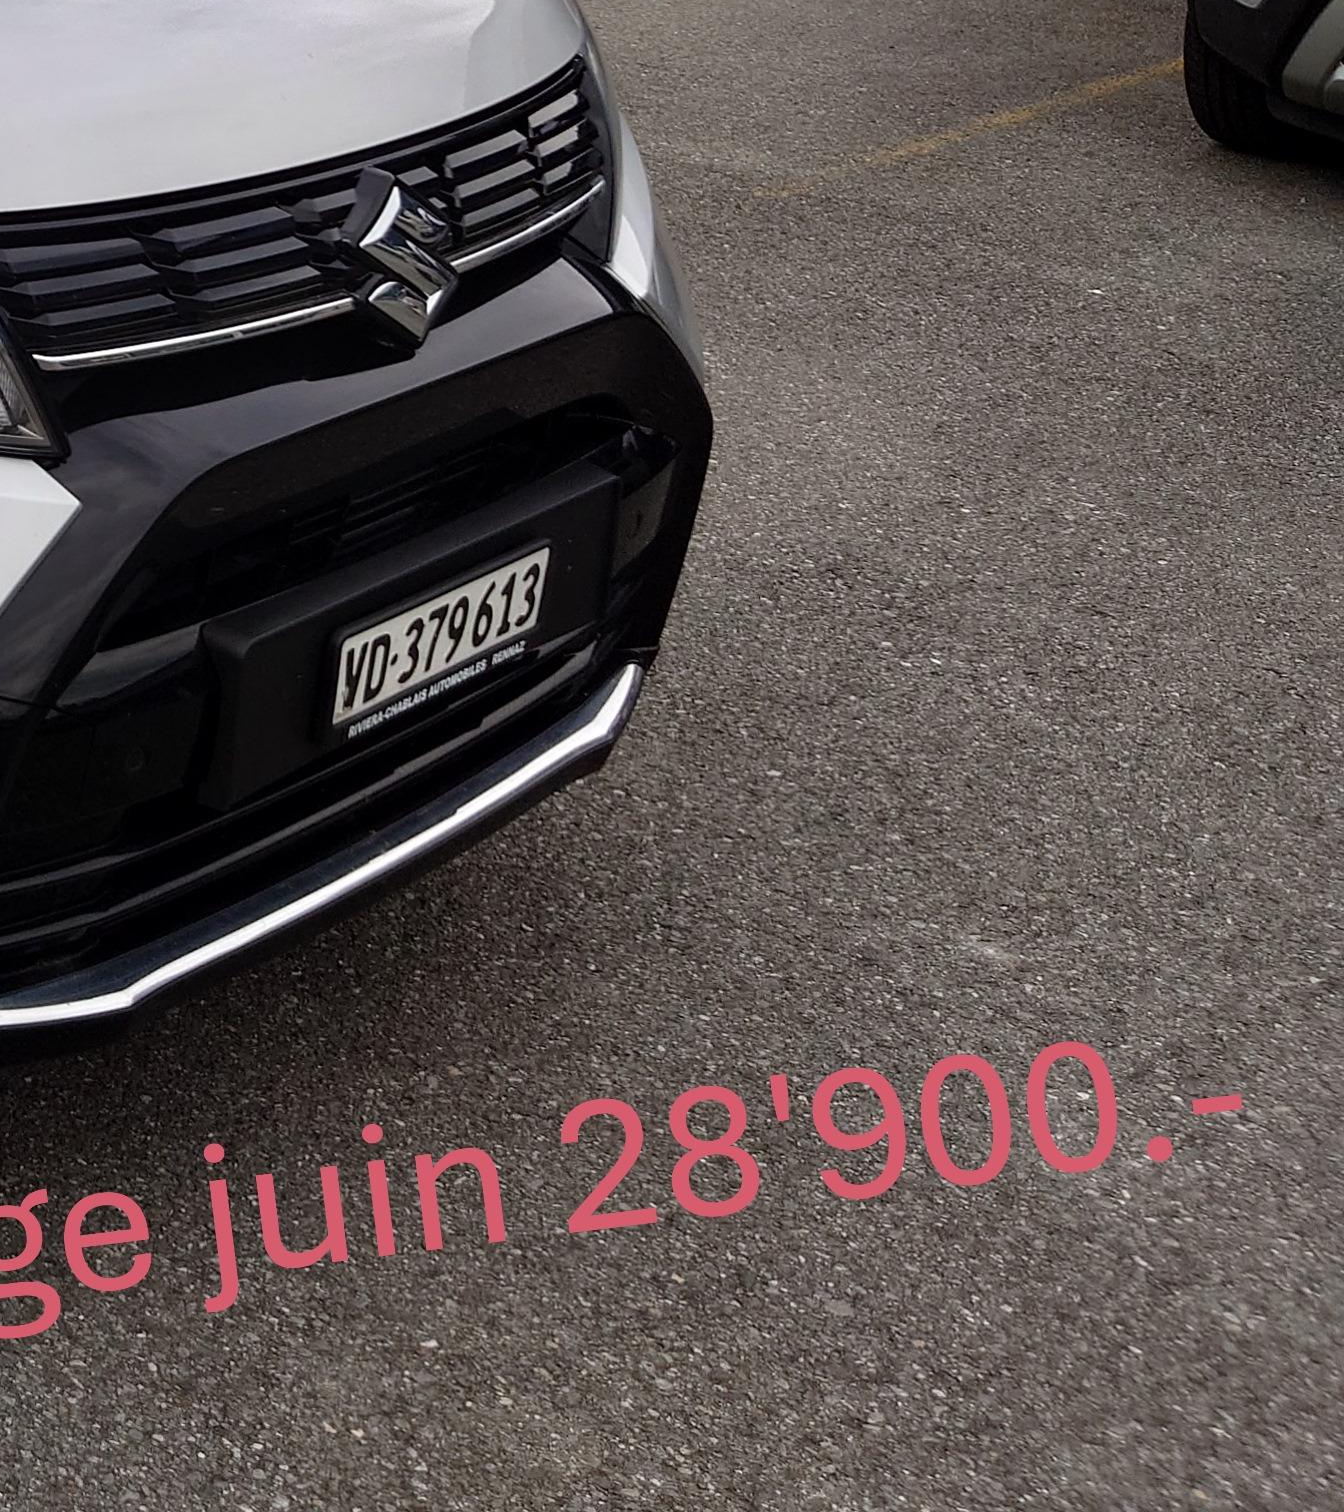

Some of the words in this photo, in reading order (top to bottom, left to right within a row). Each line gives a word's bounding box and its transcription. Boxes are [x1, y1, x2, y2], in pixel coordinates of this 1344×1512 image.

[348, 688, 428, 739] RIVIERA-CHABLAIS
[428, 659, 488, 698] AUTOMOBILES
[492, 640, 526, 666] RENNAZ
